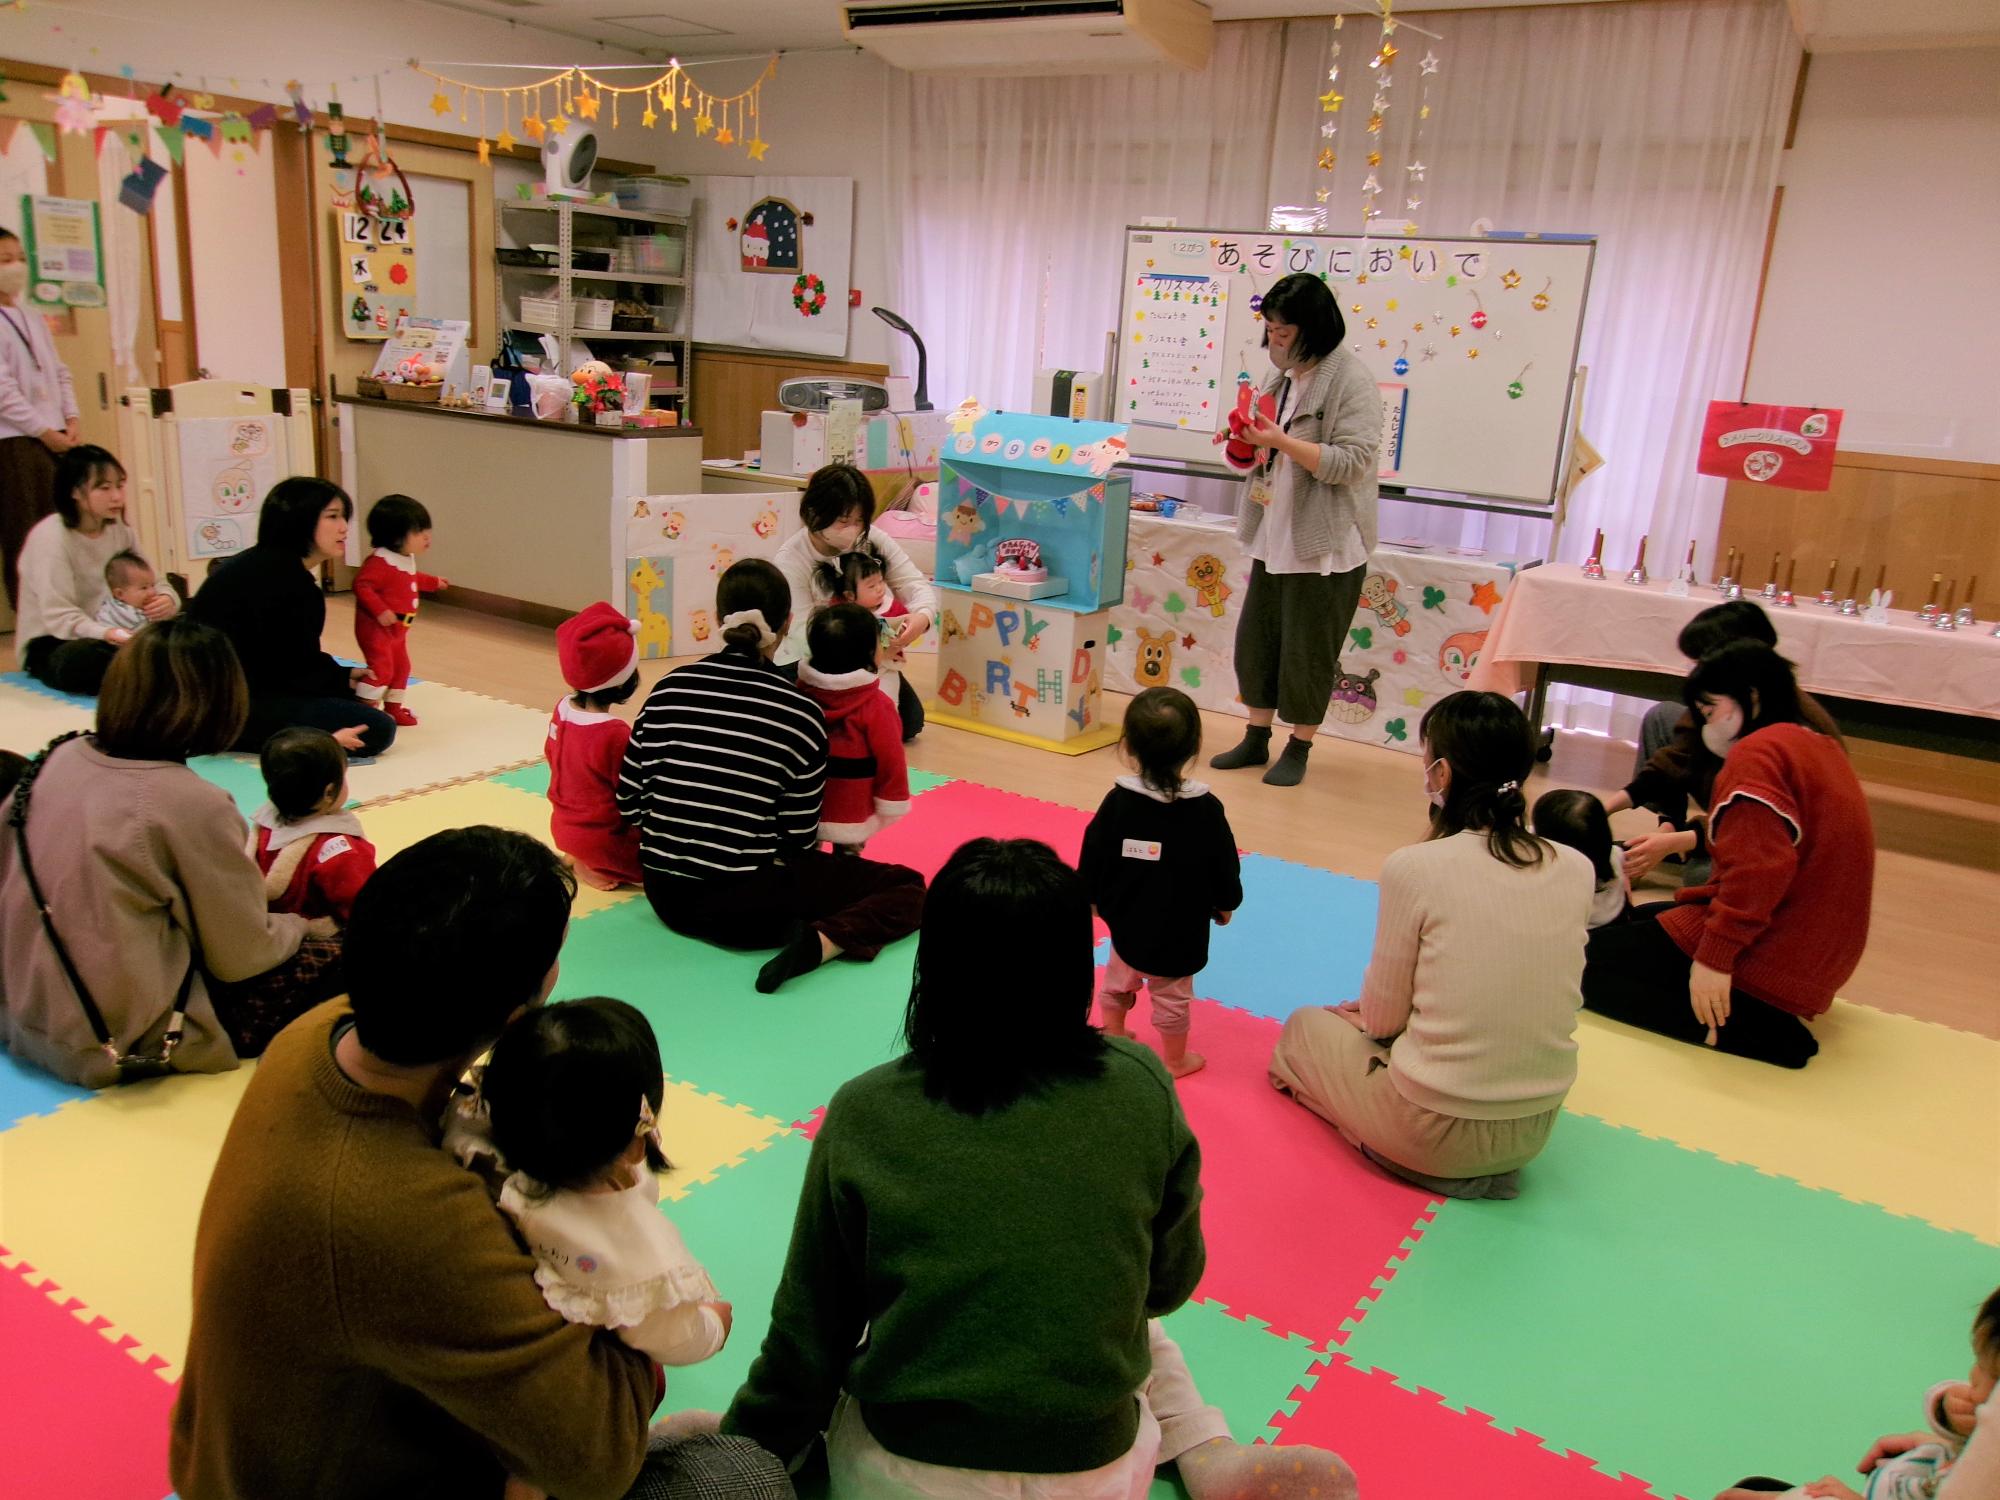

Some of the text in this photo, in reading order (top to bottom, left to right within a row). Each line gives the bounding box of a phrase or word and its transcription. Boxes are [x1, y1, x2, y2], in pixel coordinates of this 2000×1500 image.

[351, 216, 369, 240] 12
[1218, 242, 1480, 277] あそびにおいで
